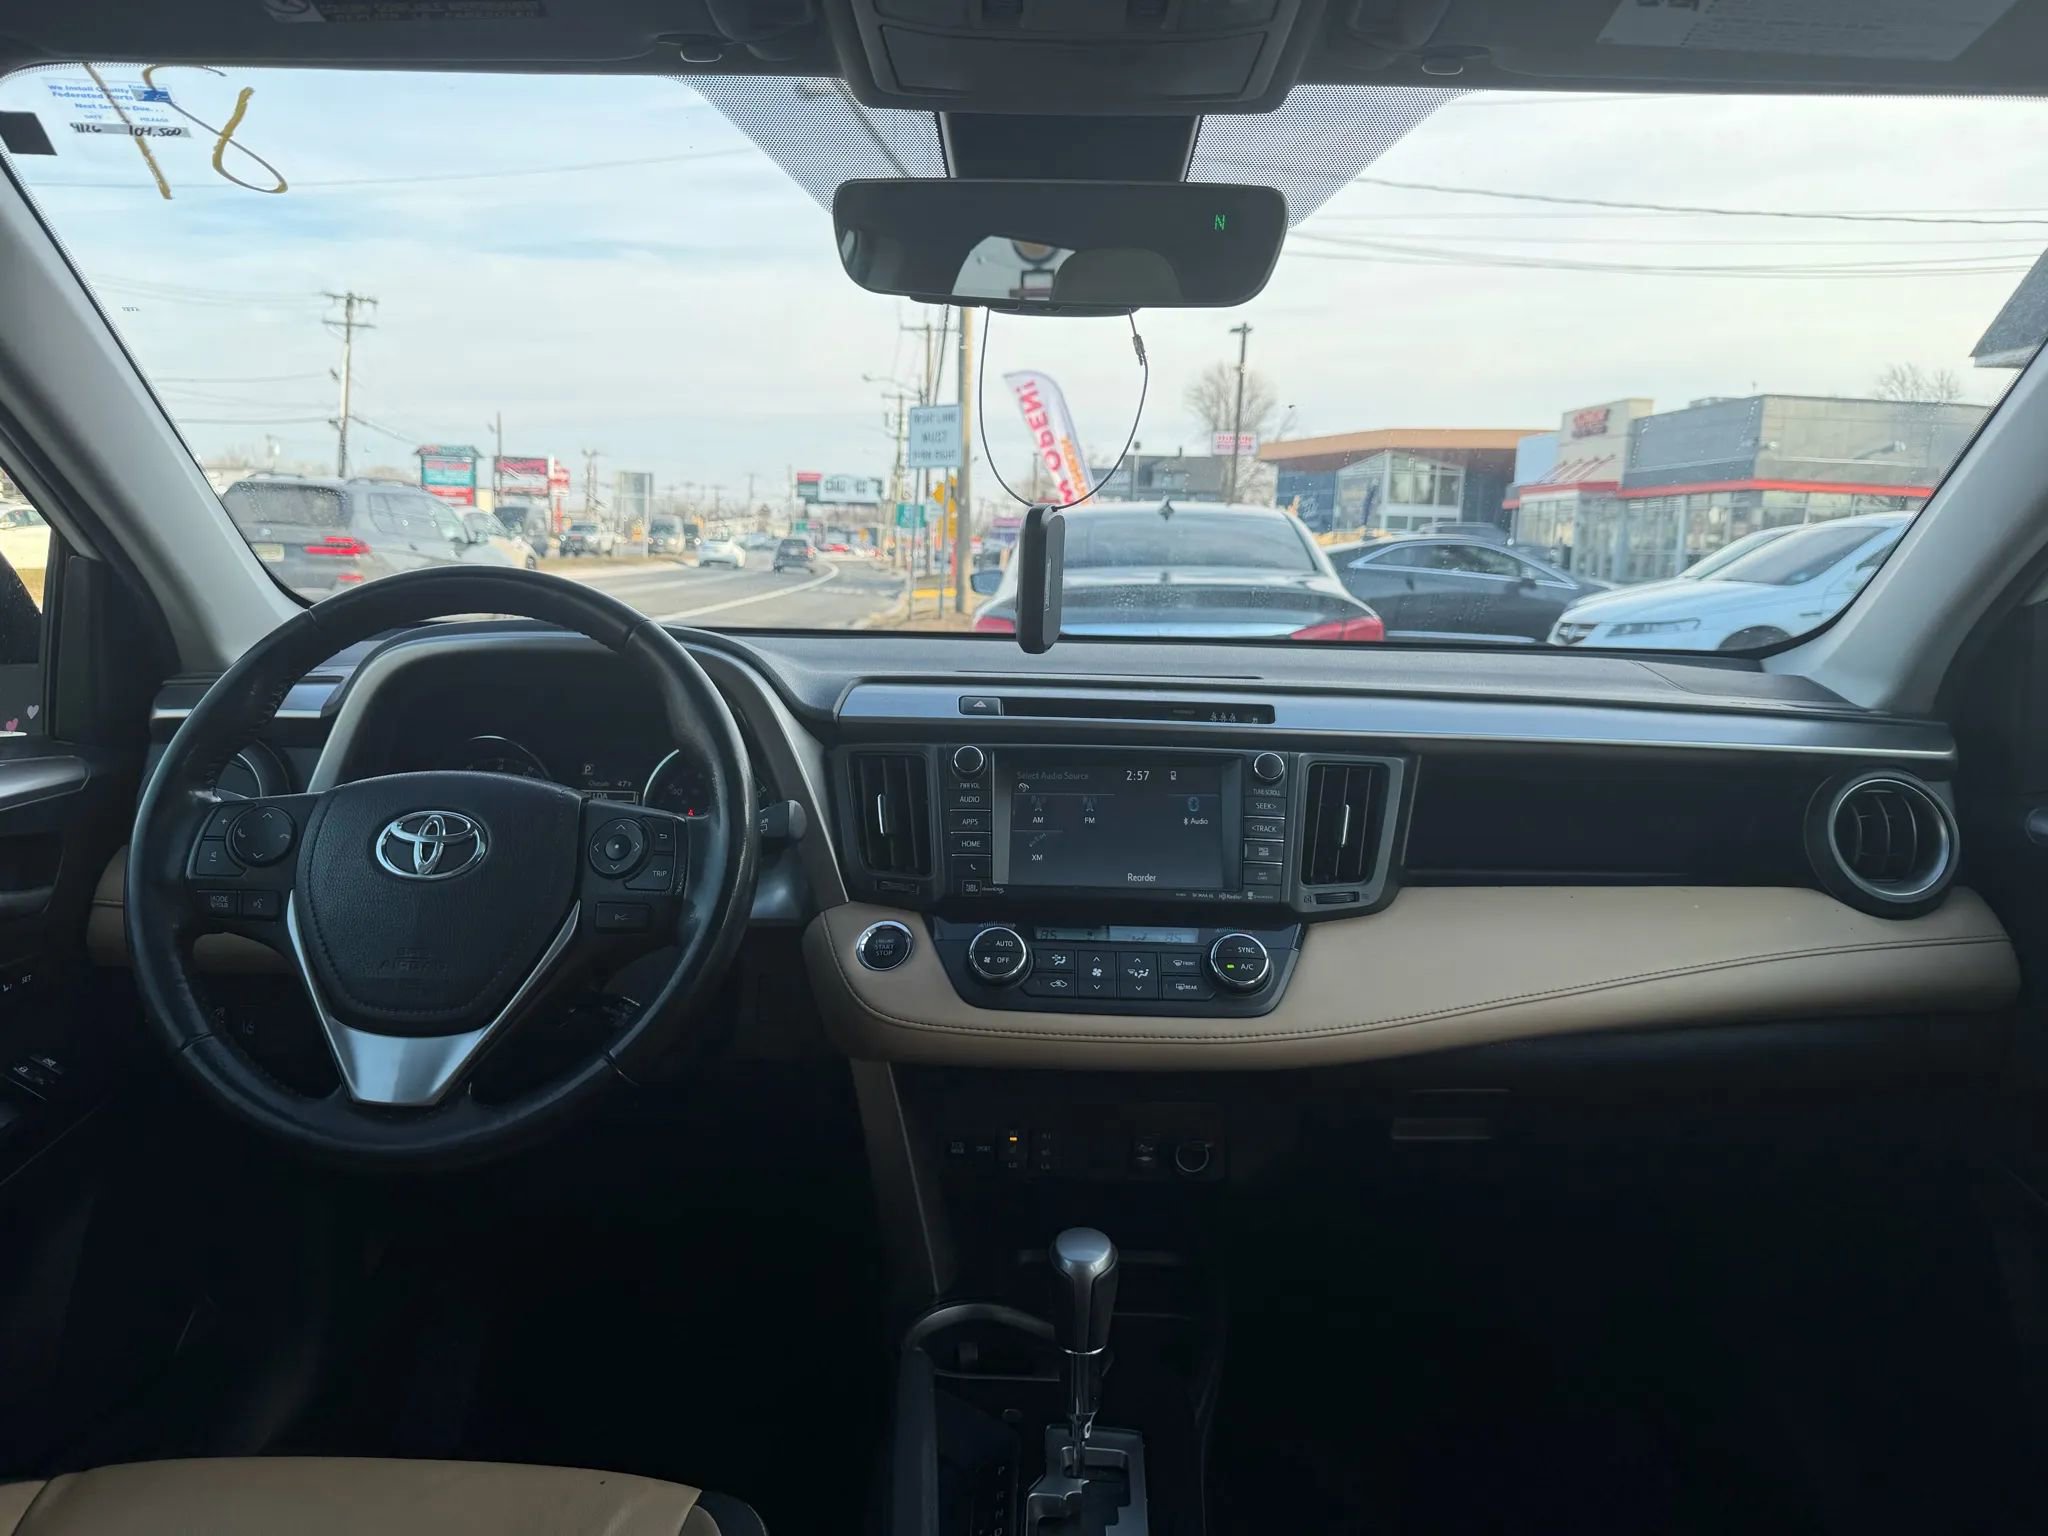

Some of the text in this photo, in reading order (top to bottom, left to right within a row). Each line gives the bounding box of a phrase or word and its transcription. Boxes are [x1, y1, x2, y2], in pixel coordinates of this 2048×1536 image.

[64, 84, 94, 92] Install
[52, 91, 105, 99] Federated
[1214, 214, 1225, 231] N
[1063, 771, 1088, 780] Source
[1126, 770, 1150, 781] 2:57
[959, 795, 980, 803] AUDIO
[961, 818, 979, 826] APPS
[1032, 816, 1044, 824] AM
[1084, 816, 1096, 824] FM
[1190, 817, 1209, 825] Audio
[960, 840, 981, 848] HOME
[1031, 854, 1043, 862] XM
[1127, 872, 1157, 882] Reorder
[995, 939, 1013, 947] AUTO
[996, 956, 1010, 964] OFF
[1240, 963, 1254, 971] A/C
